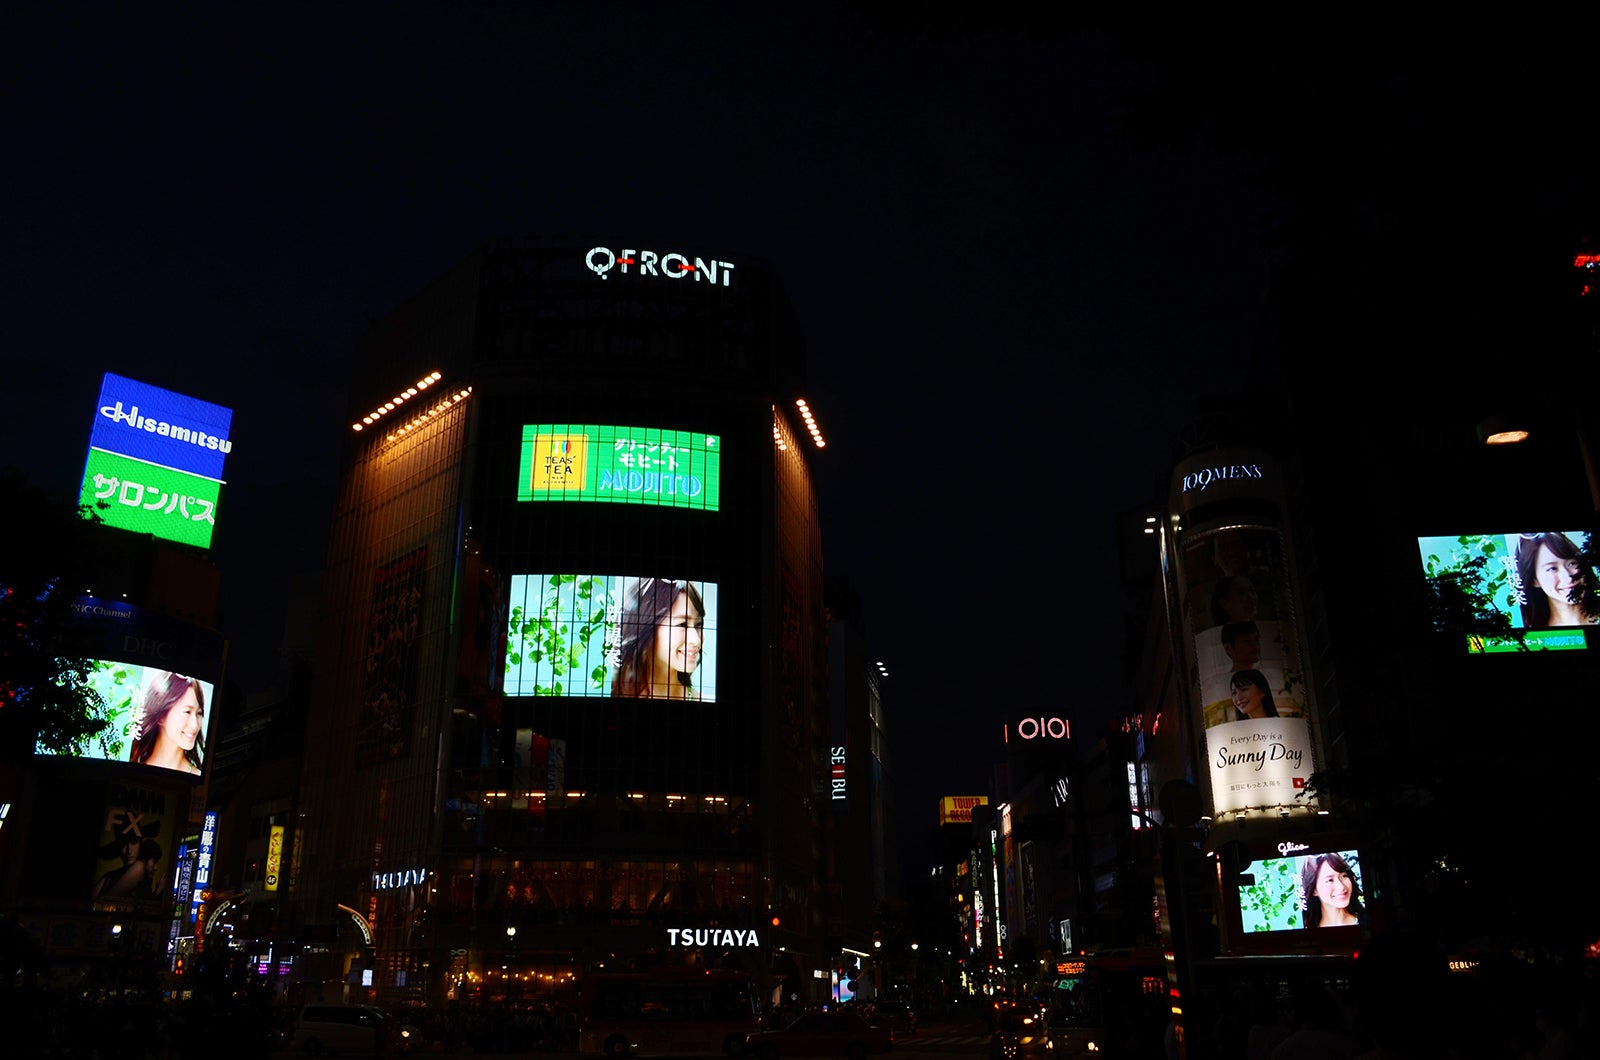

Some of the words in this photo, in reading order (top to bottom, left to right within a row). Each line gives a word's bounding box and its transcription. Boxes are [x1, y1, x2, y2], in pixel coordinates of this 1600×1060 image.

[585, 246, 735, 287] QFRONT
[100, 401, 233, 454] Hisamitsu
[614, 437, 690, 455] グリーンティー
[544, 465, 572, 474] TEA
[619, 453, 679, 472] モヒート
[600, 469, 702, 497] MOJITO
[93, 472, 215, 526] サロンパス
[92, 606, 131, 619] Channel
[1520, 637, 1543, 647] ヒート
[1230, 736, 1252, 745] Every
[1252, 733, 1268, 743] Day
[1270, 732, 1277, 740] is
[1216, 747, 1267, 772] Sunny
[1268, 742, 1303, 770] Day
[831, 746, 847, 801] SEIBU
[104, 809, 145, 838] FX
[666, 928, 760, 947] TSUTAYA
